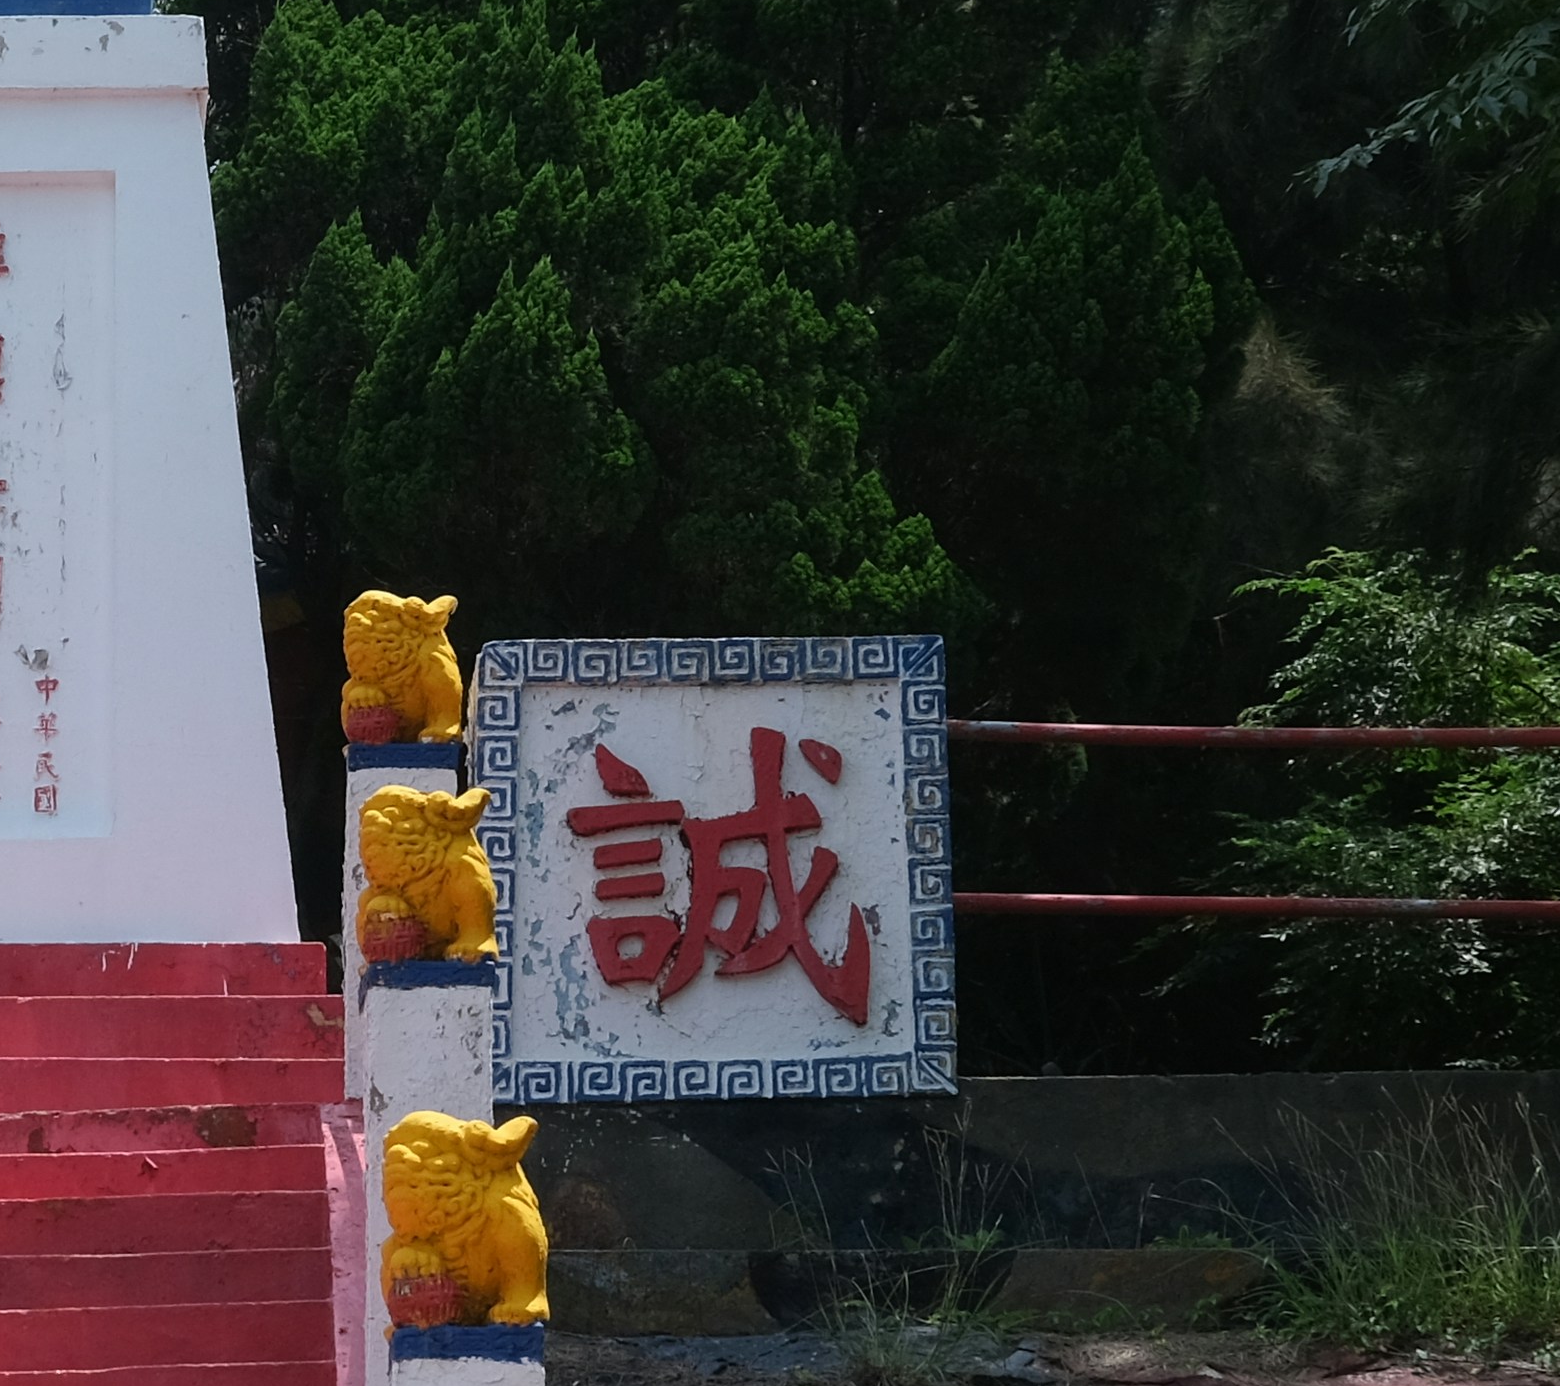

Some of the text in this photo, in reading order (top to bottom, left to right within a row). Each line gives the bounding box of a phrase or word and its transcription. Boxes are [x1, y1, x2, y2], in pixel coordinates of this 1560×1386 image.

[33, 674, 60, 814] 中華民國
[567, 726, 871, 1027] 誠
